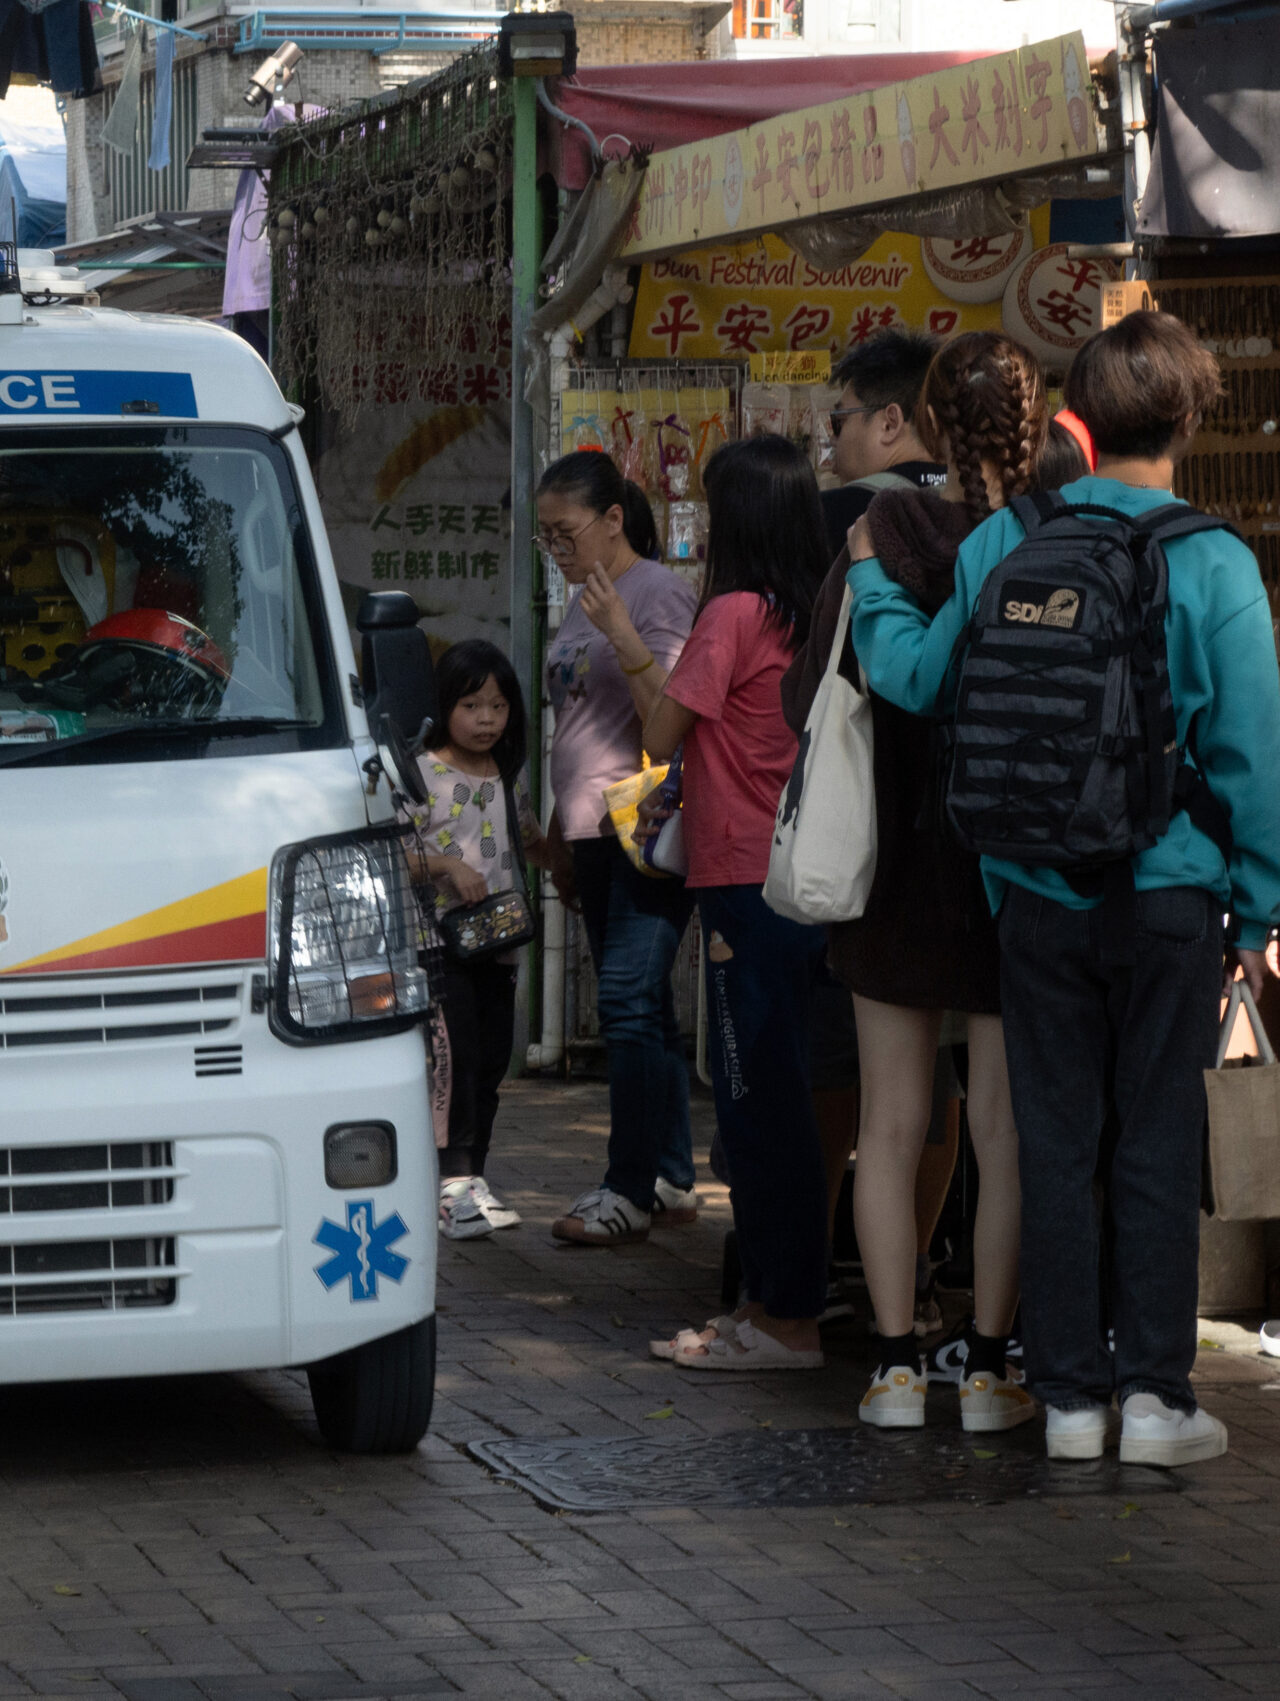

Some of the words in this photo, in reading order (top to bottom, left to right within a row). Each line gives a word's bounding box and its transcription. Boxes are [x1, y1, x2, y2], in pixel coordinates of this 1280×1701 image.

[928, 52, 1053, 170] 大米刻字
[752, 104, 885, 216] 平安包精品
[653, 258, 702, 281] Bun
[710, 254, 798, 286] Festival
[803, 256, 909, 288] Souvenir
[370, 504, 500, 535] 人手天天
[1004, 600, 1044, 624] SDI
